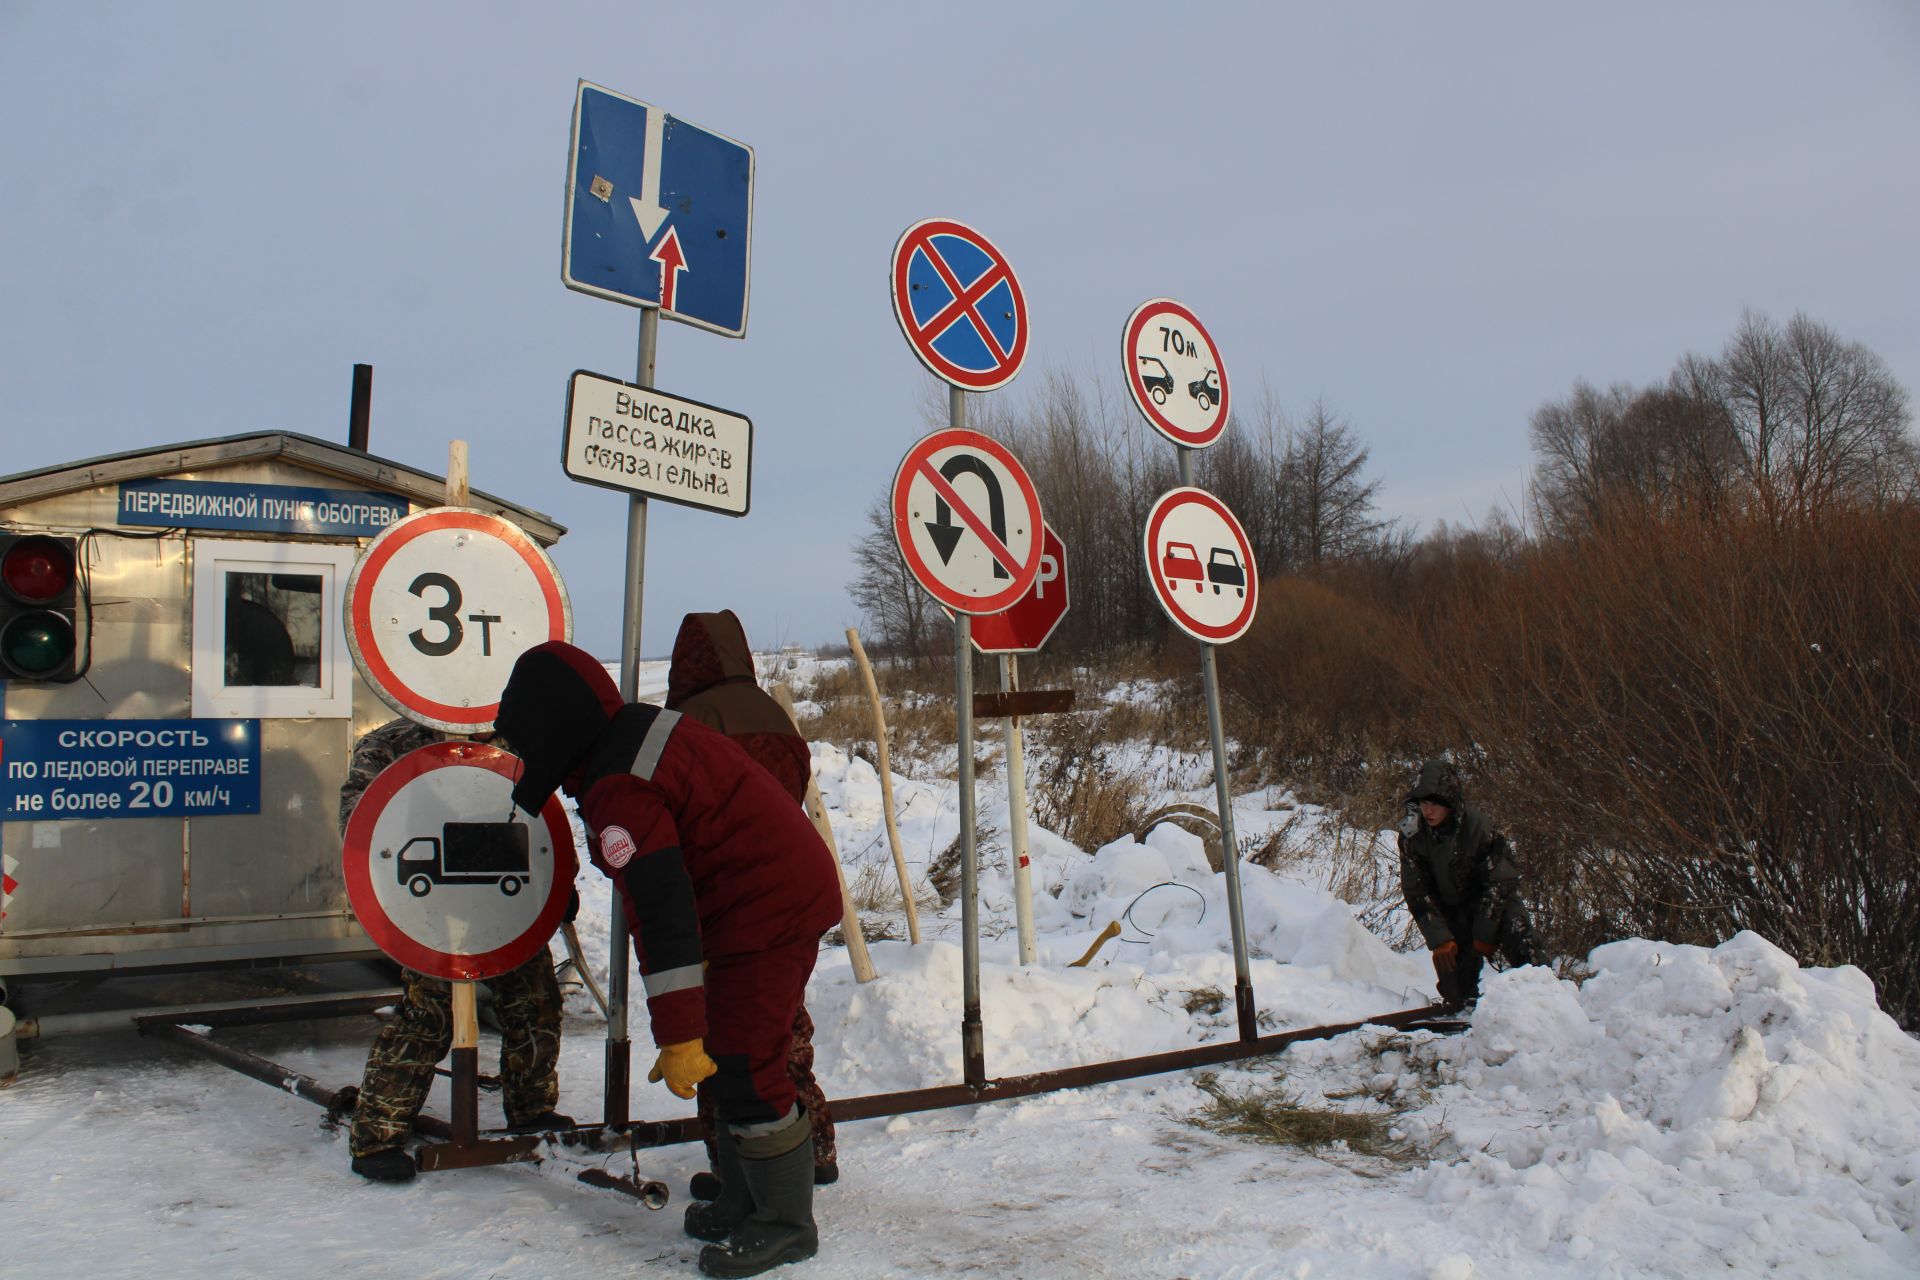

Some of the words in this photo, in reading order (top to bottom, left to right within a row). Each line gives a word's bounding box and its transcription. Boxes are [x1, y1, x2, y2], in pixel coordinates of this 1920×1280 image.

[615, 391, 717, 440] Высадка
[125, 490, 258, 519] ПЕРЕДВИЖНОЙ
[262, 498, 316, 521] ПУНКТ
[317, 502, 400, 527] ОБОГРЕВА
[58, 730, 210, 748] СКОРОСТЬ
[8, 761, 38, 779] ПО
[42, 756, 138, 780] ЛЕДОВОЙ
[142, 758, 250, 777] ПЕРЕПРАВЕ
[15, 794, 44, 811] не
[51, 787, 122, 811] более
[128, 780, 174, 809] 20
[184, 785, 231, 808] км/ч
